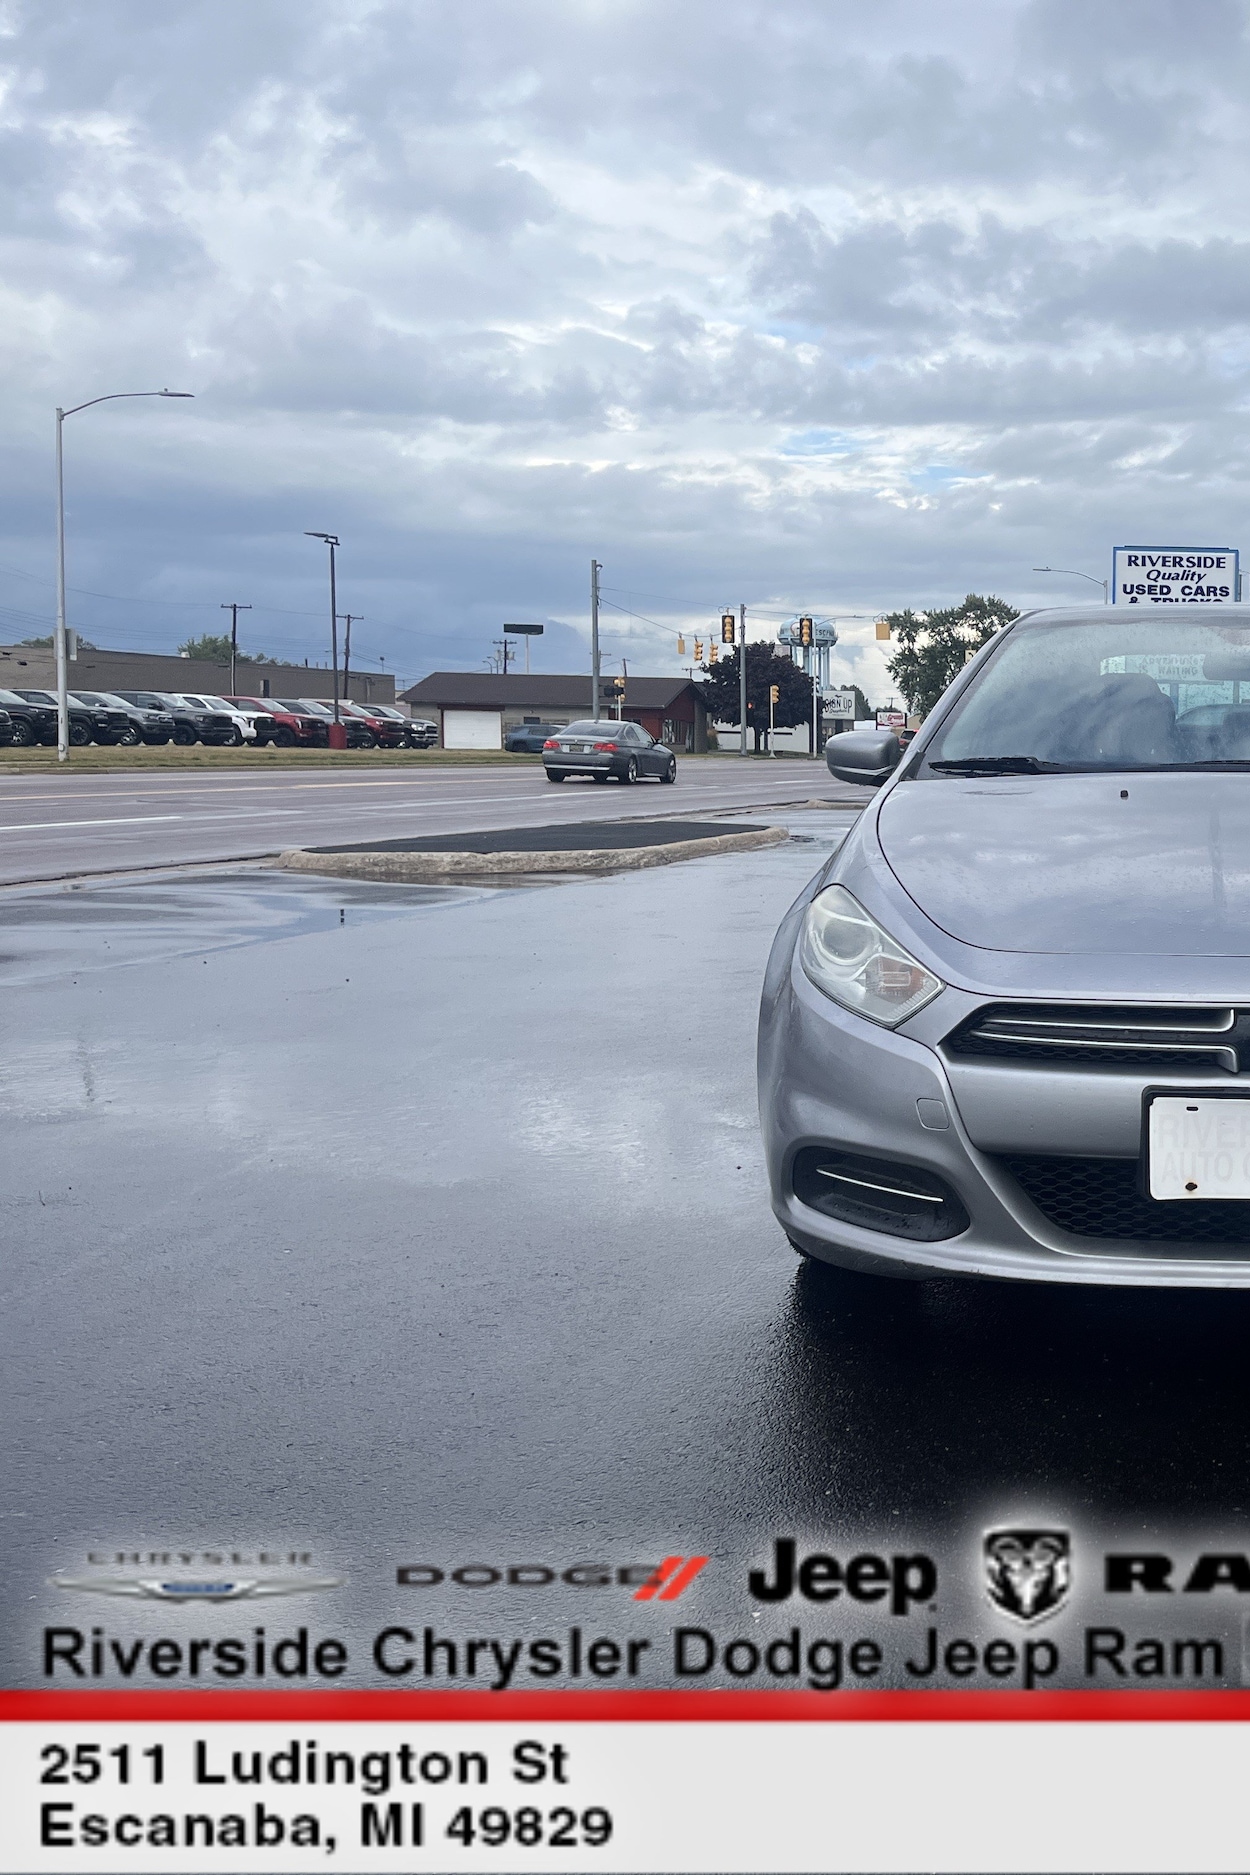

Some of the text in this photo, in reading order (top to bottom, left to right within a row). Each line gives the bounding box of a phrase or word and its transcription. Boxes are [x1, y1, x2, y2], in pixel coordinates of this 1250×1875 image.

[1127, 554, 1226, 569] RIVERSIDE
[1146, 569, 1207, 585] Quality
[1122, 584, 1230, 597] USED CARS
[1161, 1151, 1234, 1183] AUTO
